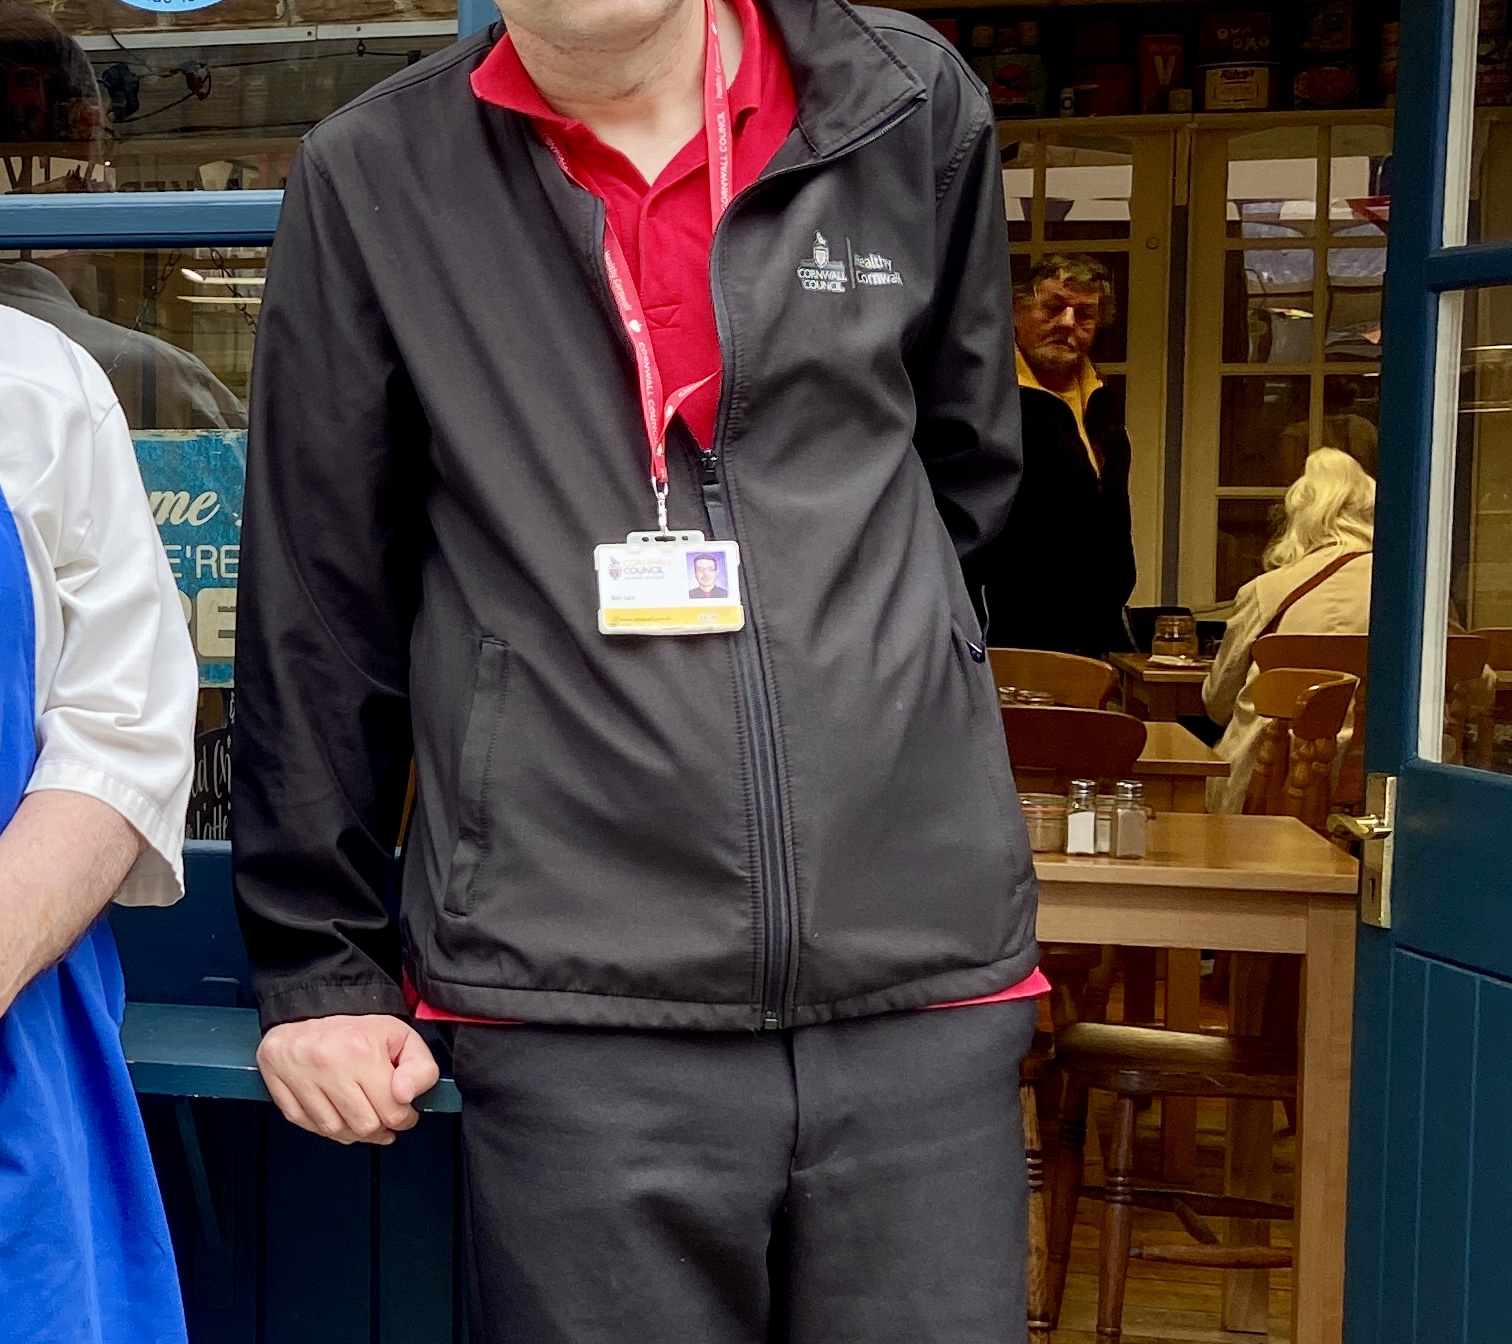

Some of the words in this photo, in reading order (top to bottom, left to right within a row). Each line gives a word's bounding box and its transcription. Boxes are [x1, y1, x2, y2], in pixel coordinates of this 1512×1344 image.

[716, 110, 727, 152] COUNCIL
[797, 268, 848, 281] CORNWALL
[803, 279, 846, 293] COUNCIL
[638, 341, 656, 397] CORNWALL
[163, 544, 240, 579] E'RE
[623, 566, 665, 575] COUNCIL
